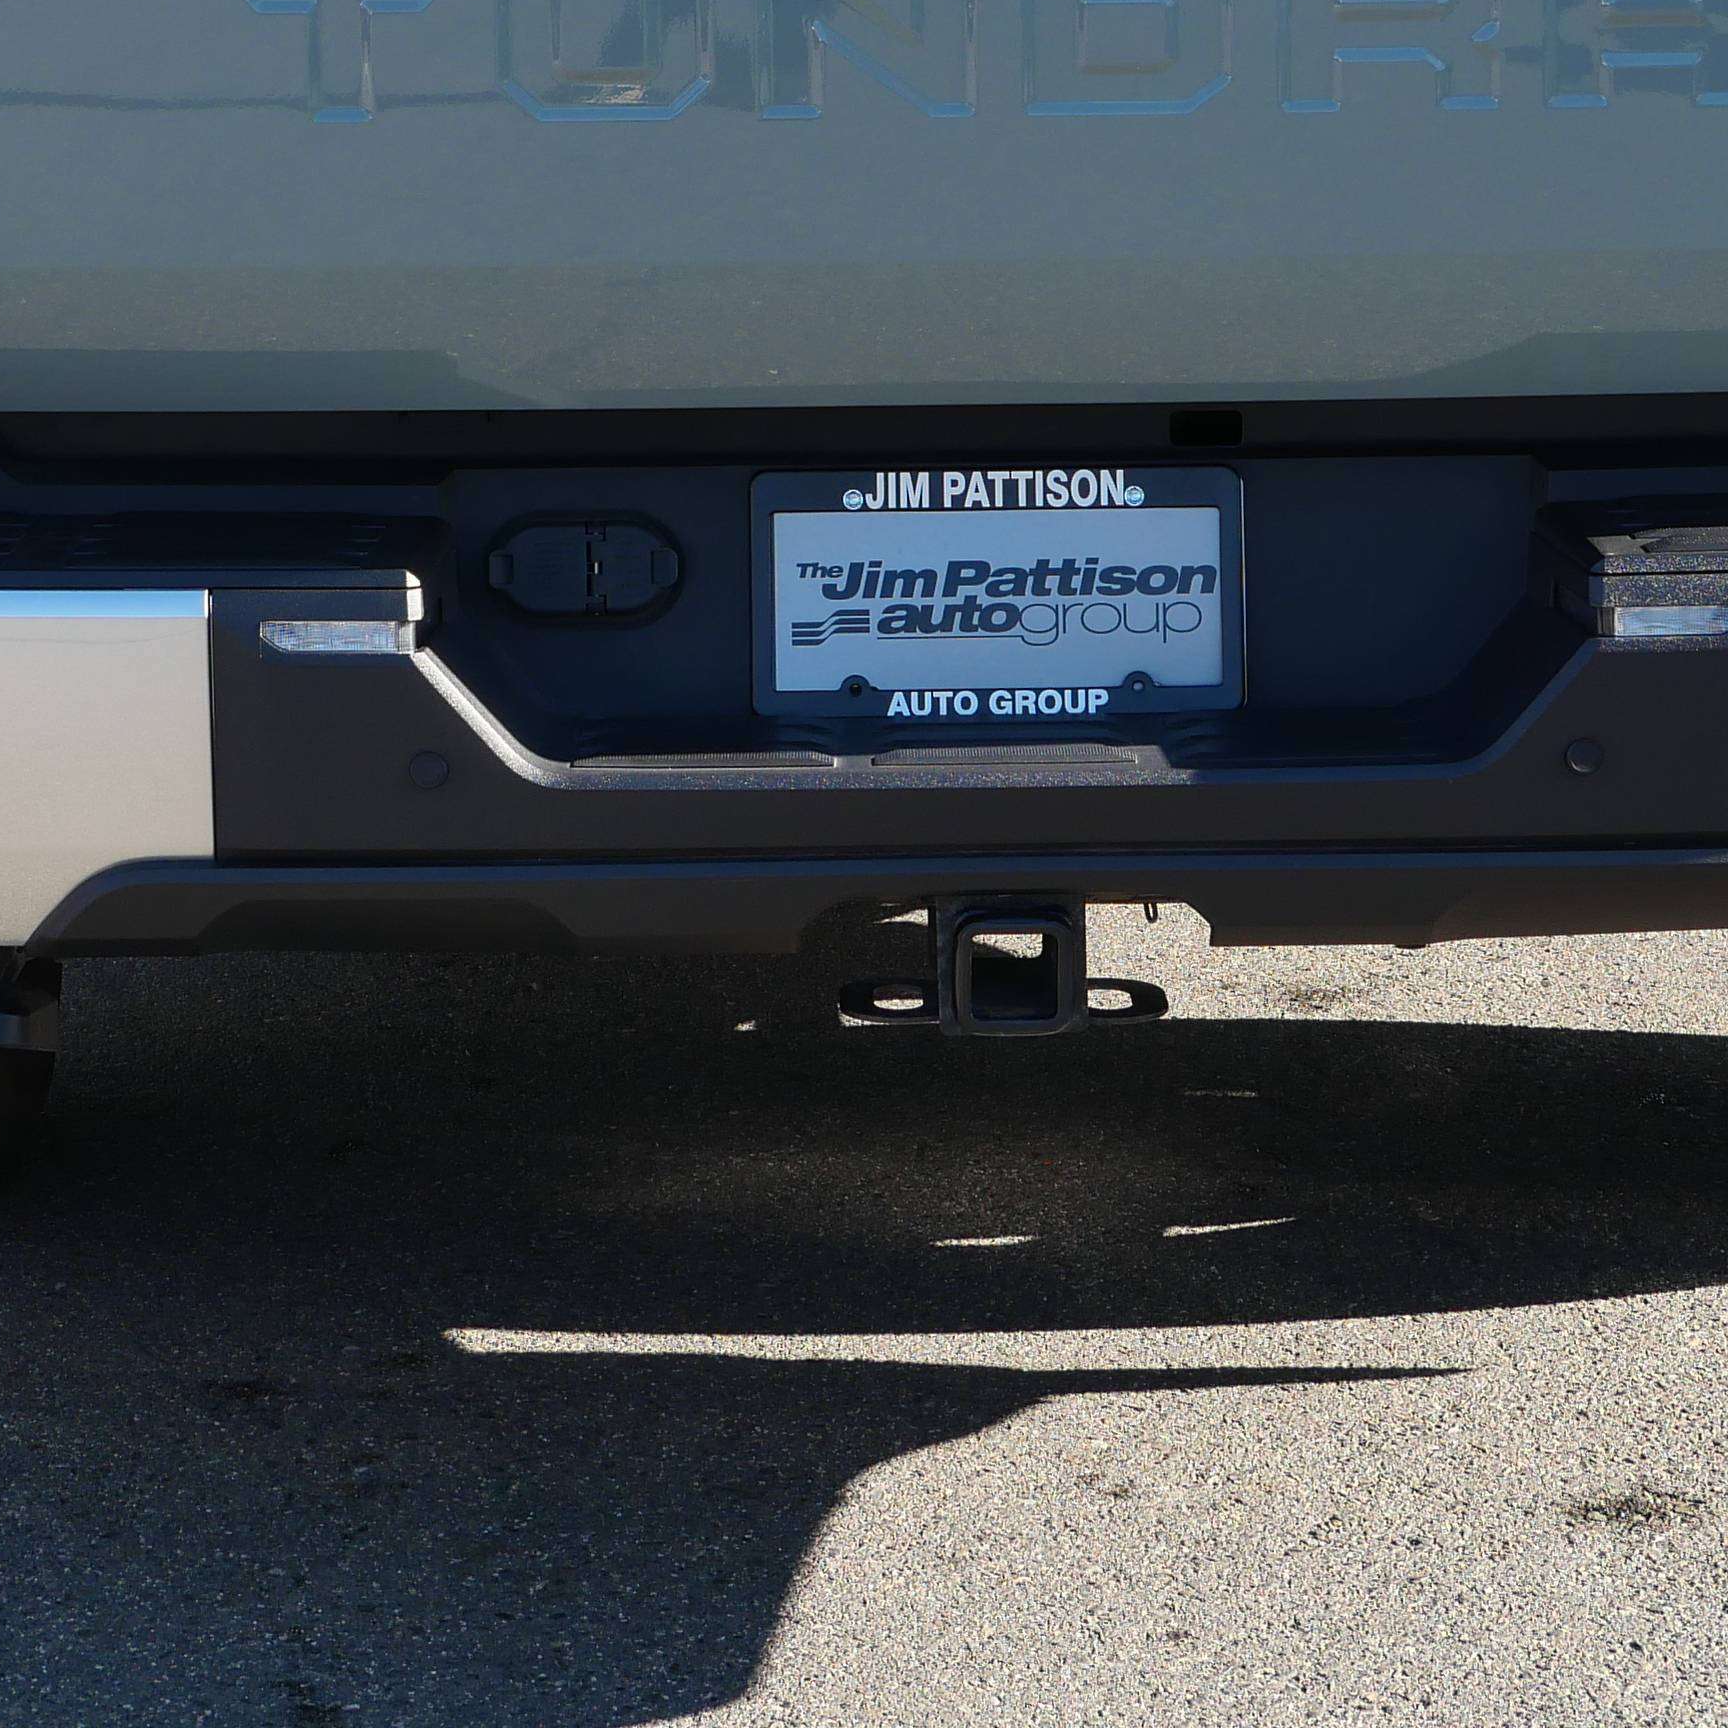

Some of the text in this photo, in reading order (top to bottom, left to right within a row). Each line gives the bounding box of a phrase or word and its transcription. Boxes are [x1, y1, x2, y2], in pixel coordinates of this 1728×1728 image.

[865, 469, 1125, 509] JIM PATTISON
[796, 557, 1218, 600] The Jim Pattison
[886, 688, 1110, 718] AUTO GROUP
